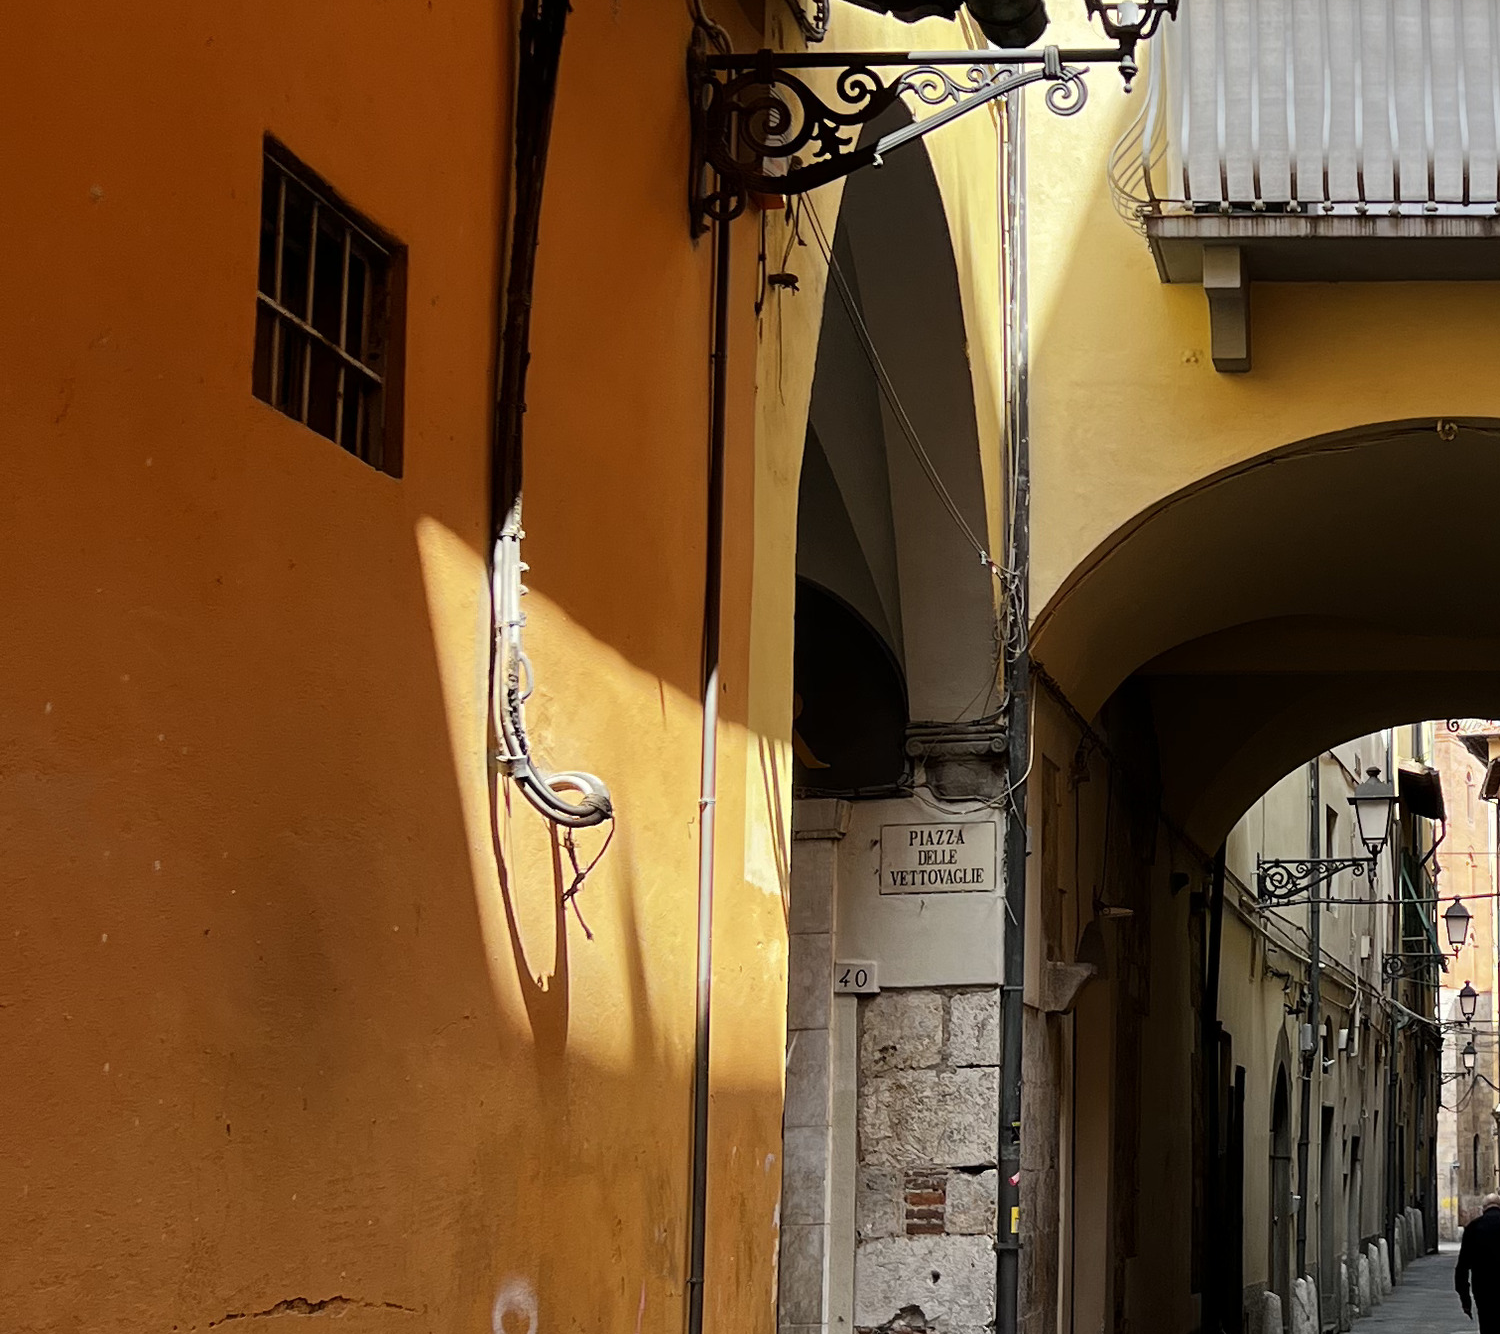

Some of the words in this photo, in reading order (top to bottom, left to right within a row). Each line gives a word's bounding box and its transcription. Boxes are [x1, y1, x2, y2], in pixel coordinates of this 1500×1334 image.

[909, 829, 965, 847] PIAZZA
[918, 849, 957, 866] DELLE
[890, 868, 984, 886] VETTOVAGLIE
[839, 969, 868, 988] 40
